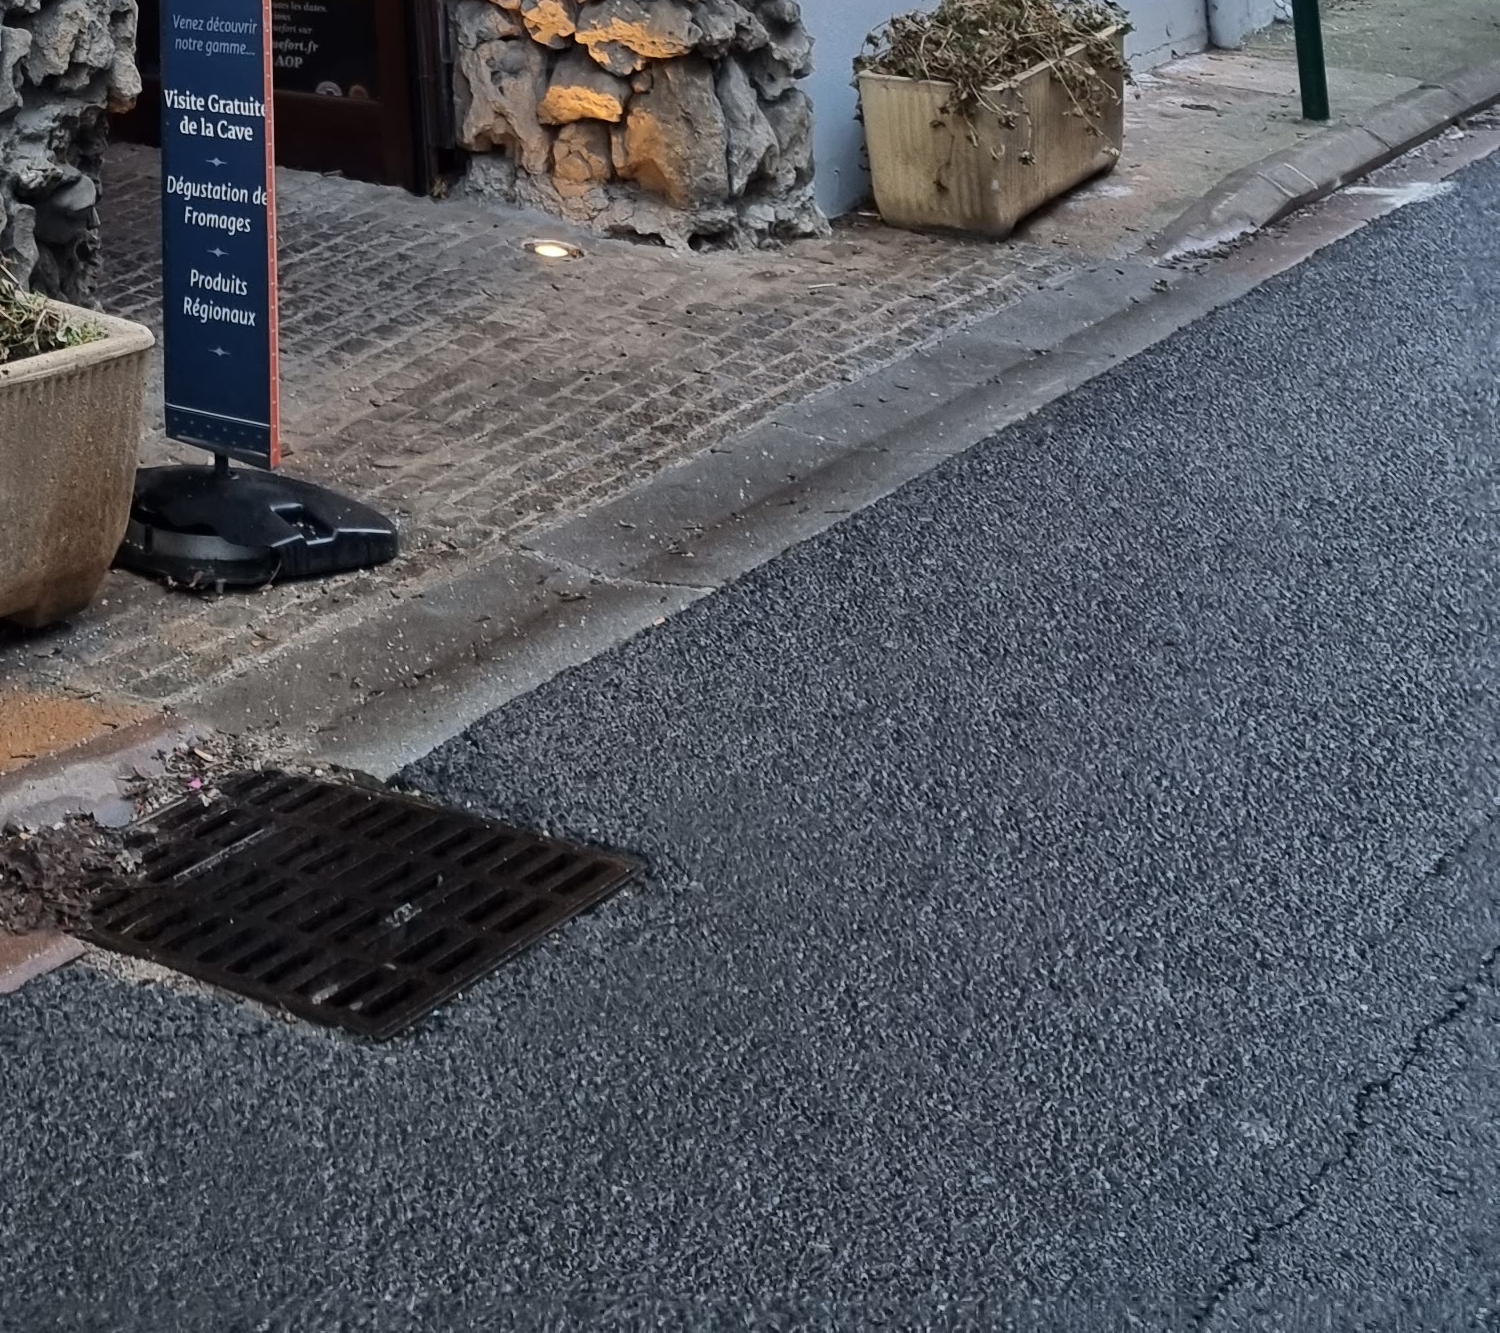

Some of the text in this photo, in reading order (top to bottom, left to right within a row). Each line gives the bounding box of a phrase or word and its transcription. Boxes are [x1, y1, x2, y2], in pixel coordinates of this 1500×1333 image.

[173, 14, 204, 31] Venez
[206, 16, 258, 34] découvrir
[175, 38, 203, 51] notre
[275, 55, 303, 68] AOP
[164, 89, 266, 117] Visite Gratuite
[180, 115, 253, 141] de la Cave
[167, 175, 267, 205] Dégustation de
[184, 206, 251, 235] Fromages
[190, 269, 247, 295] Produits
[184, 296, 256, 326] Régionaux
